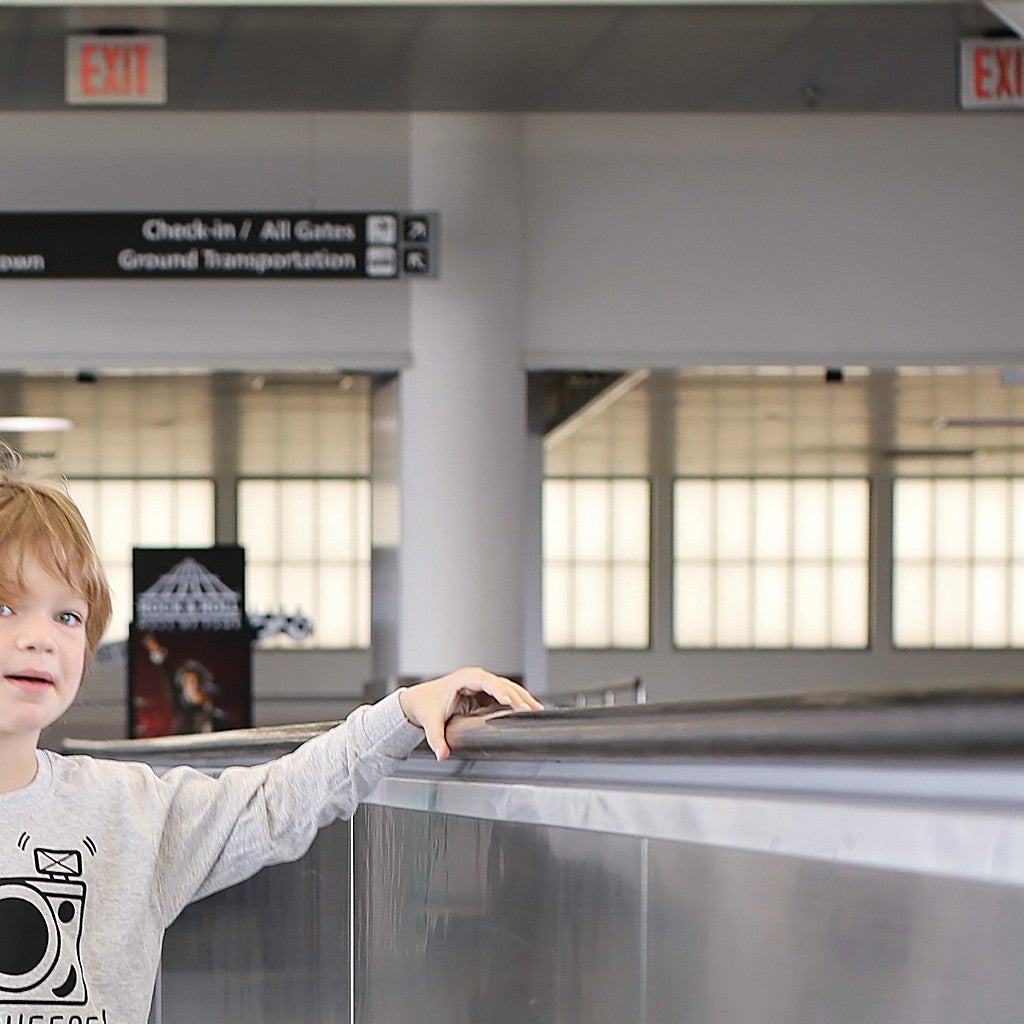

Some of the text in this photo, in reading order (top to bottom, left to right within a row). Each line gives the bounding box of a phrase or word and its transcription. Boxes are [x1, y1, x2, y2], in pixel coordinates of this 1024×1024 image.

[80, 44, 152, 96] EXIT
[974, 47, 1024, 98] EXI
[142, 218, 236, 242] Check-in
[258, 218, 291, 241] All
[293, 219, 356, 242] Gates
[117, 249, 356, 275] Ground Transportation
